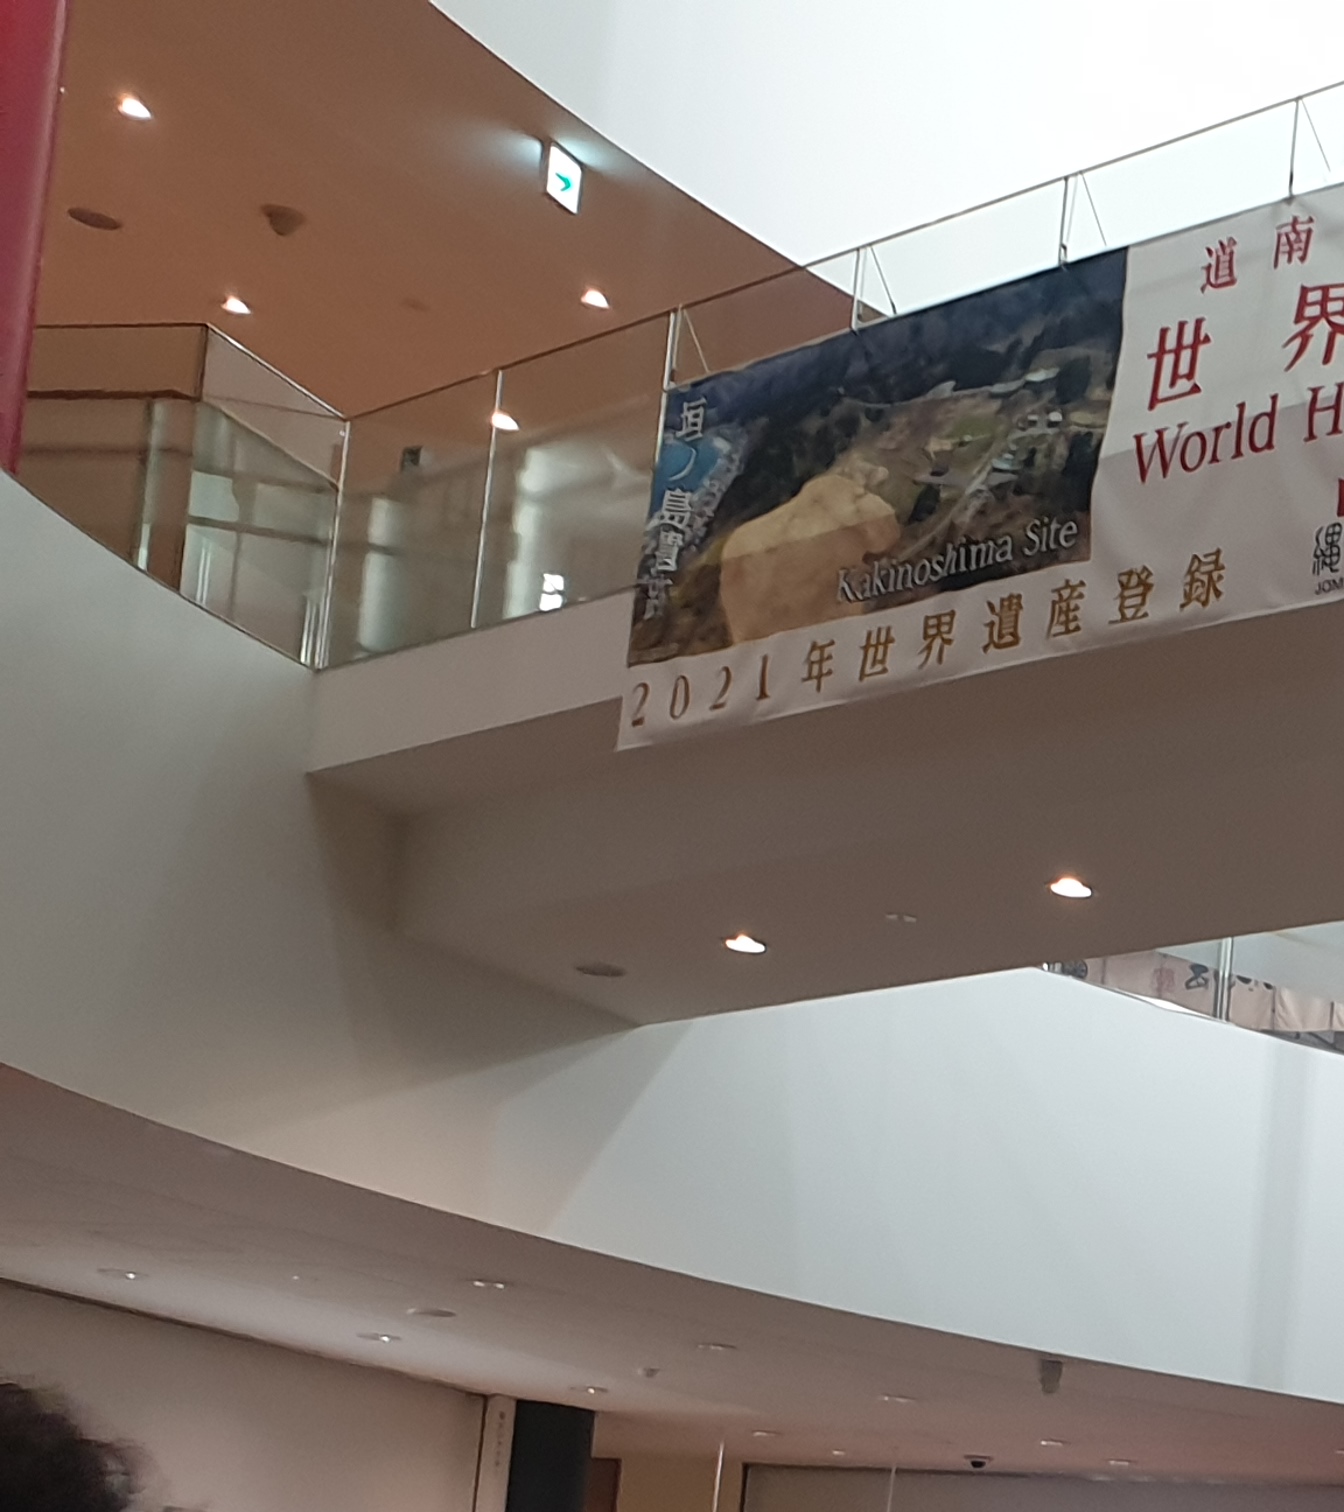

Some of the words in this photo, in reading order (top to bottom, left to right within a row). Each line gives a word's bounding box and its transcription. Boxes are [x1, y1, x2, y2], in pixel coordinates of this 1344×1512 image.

[1132, 394, 1278, 485] World
[835, 533, 1013, 604] Kakinoshima
[1025, 517, 1079, 557] Site
[631, 548, 1226, 727] 2021年世界遺産登録
